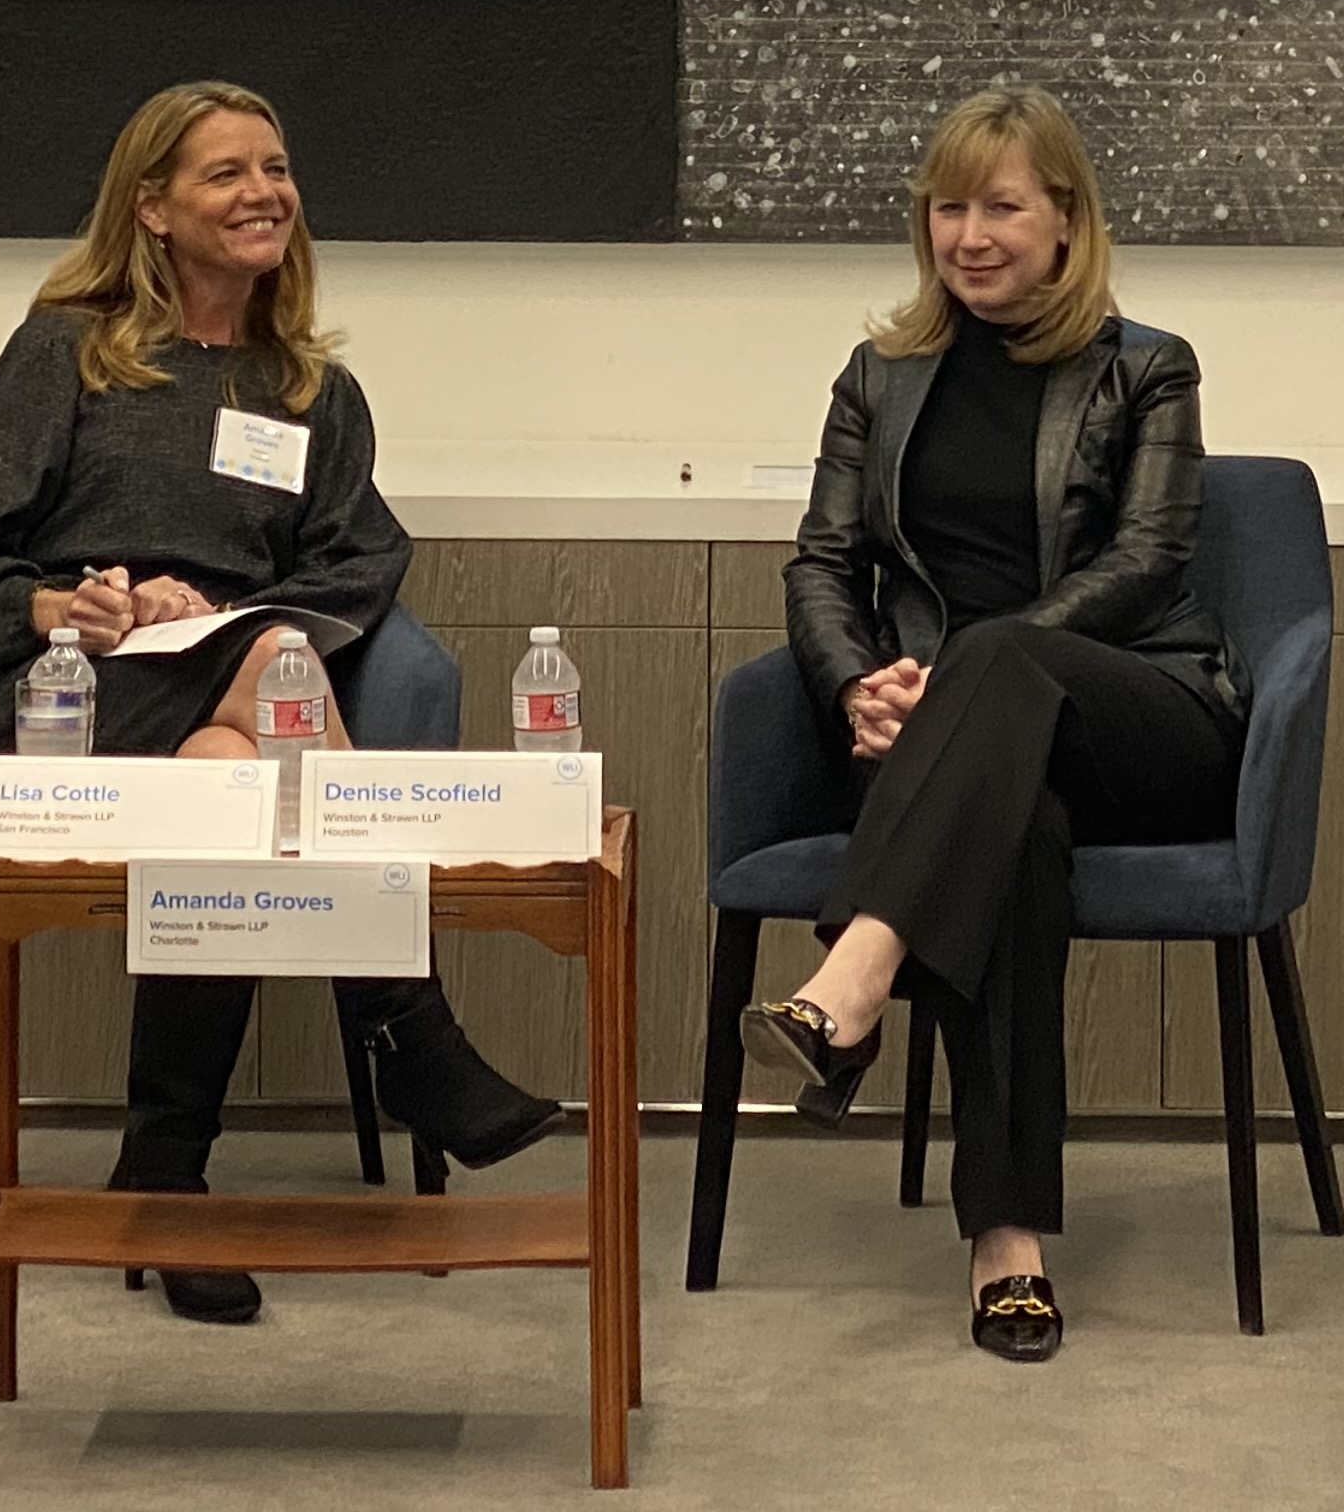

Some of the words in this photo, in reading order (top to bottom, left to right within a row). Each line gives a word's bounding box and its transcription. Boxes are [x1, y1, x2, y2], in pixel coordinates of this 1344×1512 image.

[0, 784, 43, 802] Lisa
[51, 784, 121, 802] Cottle
[324, 782, 403, 802] Denise
[410, 783, 502, 803] Scofield
[43, 812, 51, 822] &
[54, 812, 92, 822] Strawn
[94, 812, 116, 822] LLP
[323, 812, 368, 823] Winston
[369, 813, 378, 823] &
[381, 813, 419, 824] Strawn
[421, 813, 442, 824] LLP
[19, 824, 71, 835] Francisco
[322, 827, 369, 838] Houston
[150, 889, 247, 910] Amanda
[253, 891, 335, 912] Groves
[149, 920, 194, 932] Winston
[196, 921, 205, 932] &
[207, 921, 247, 933] Strawn
[247, 921, 269, 933] LLP
